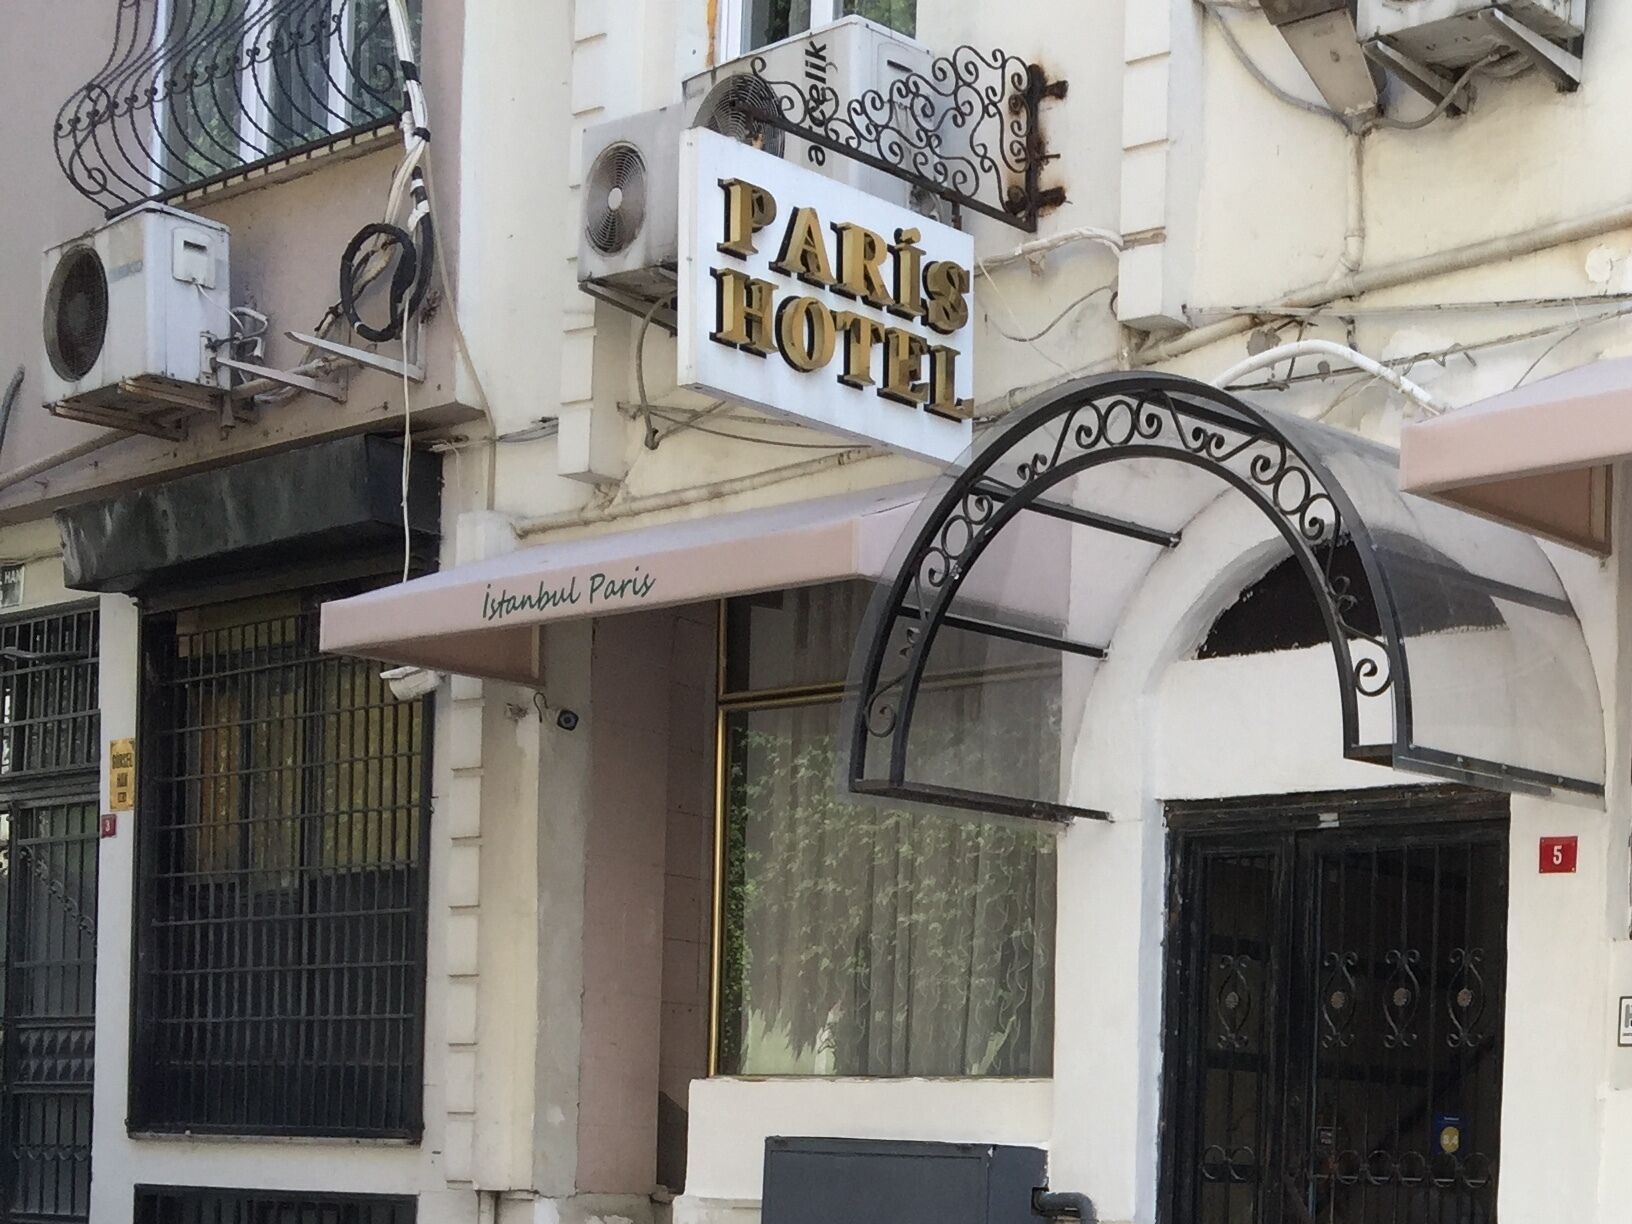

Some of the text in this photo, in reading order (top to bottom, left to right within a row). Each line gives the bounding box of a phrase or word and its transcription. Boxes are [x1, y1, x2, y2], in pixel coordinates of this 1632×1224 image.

[717, 177, 970, 335] PARİS
[709, 266, 974, 423] HOTEL
[482, 566, 656, 621] İstanbul Paris
[1552, 845, 1563, 865] 5
